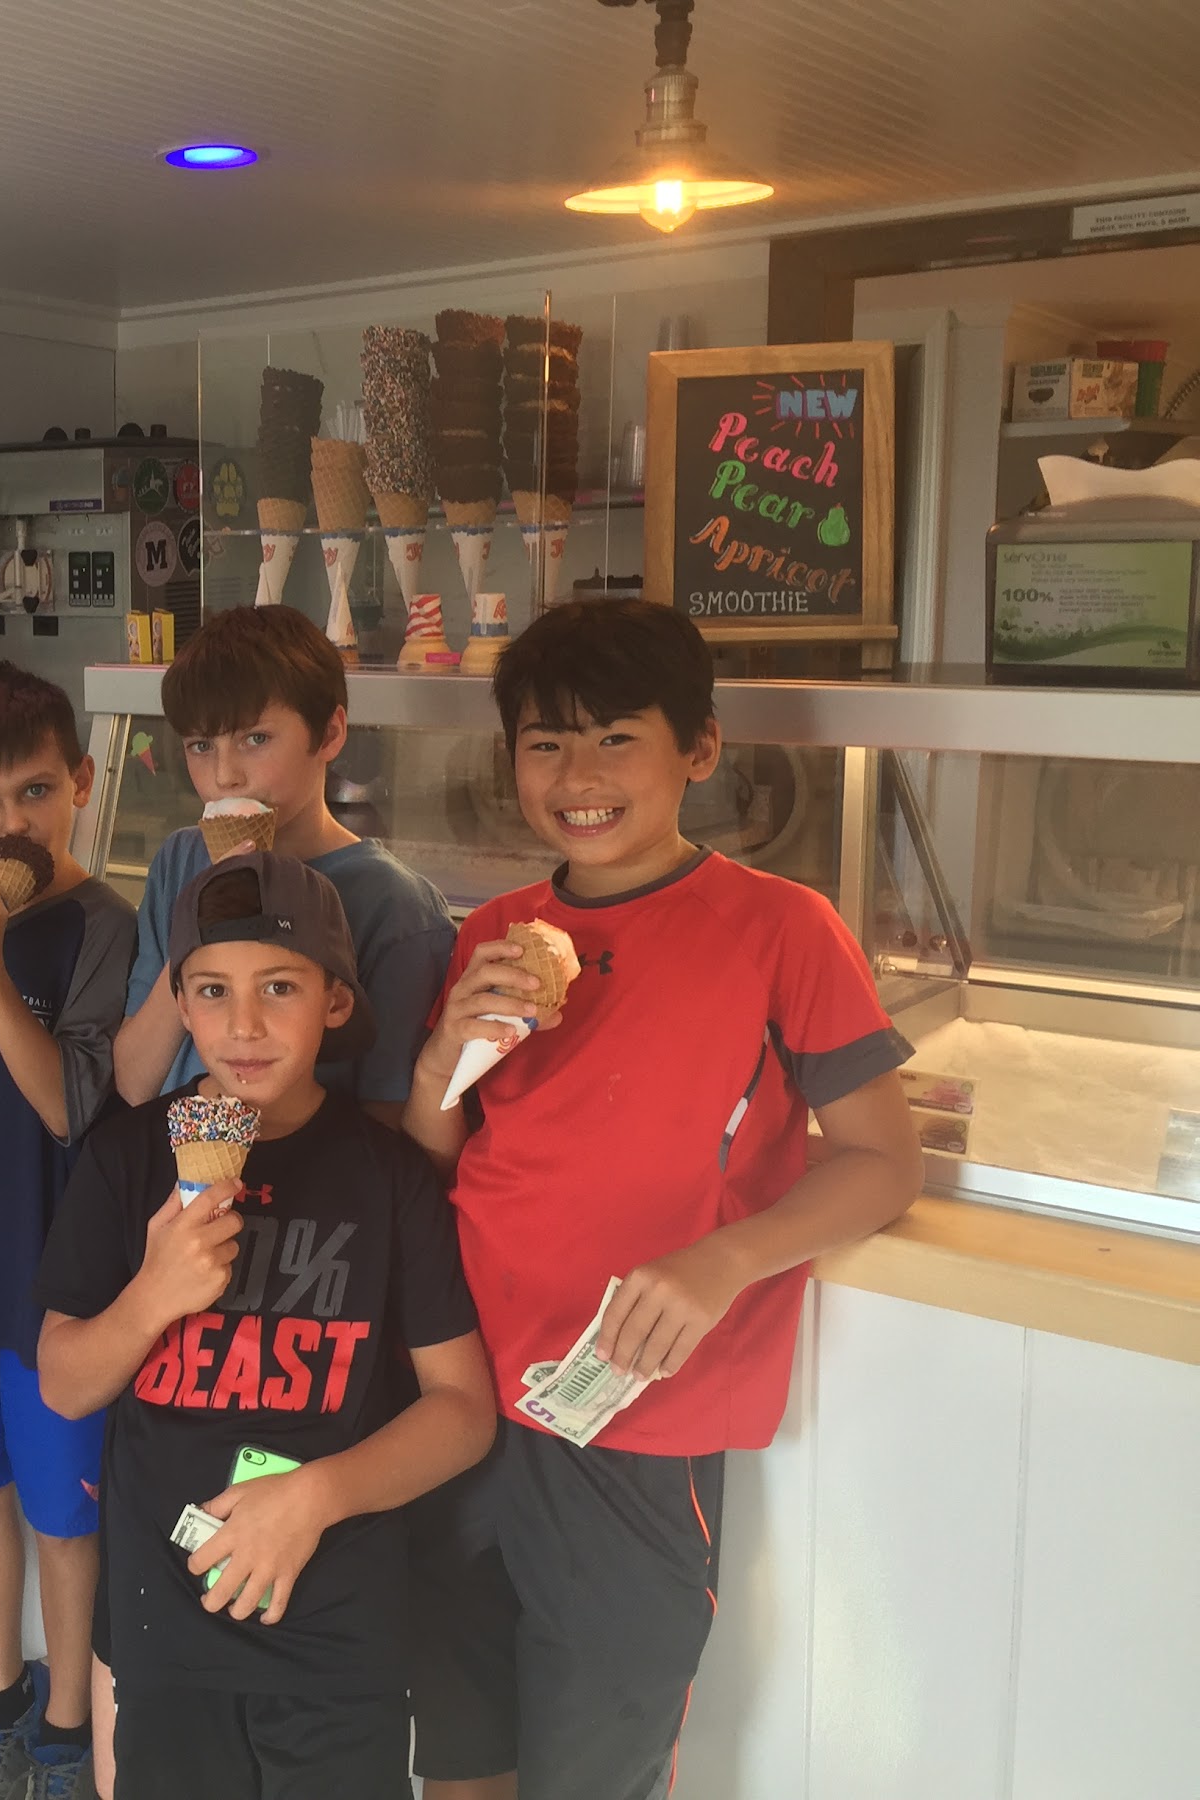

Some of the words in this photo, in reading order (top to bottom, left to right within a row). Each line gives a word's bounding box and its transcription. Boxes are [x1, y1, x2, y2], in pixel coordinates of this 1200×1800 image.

[776, 387, 859, 421] NEW
[708, 411, 840, 488] Peach
[708, 459, 816, 529] Pear
[688, 514, 856, 604] Apricot
[1001, 587, 1055, 603] 100%
[133, 1310, 372, 1415] BEAST
